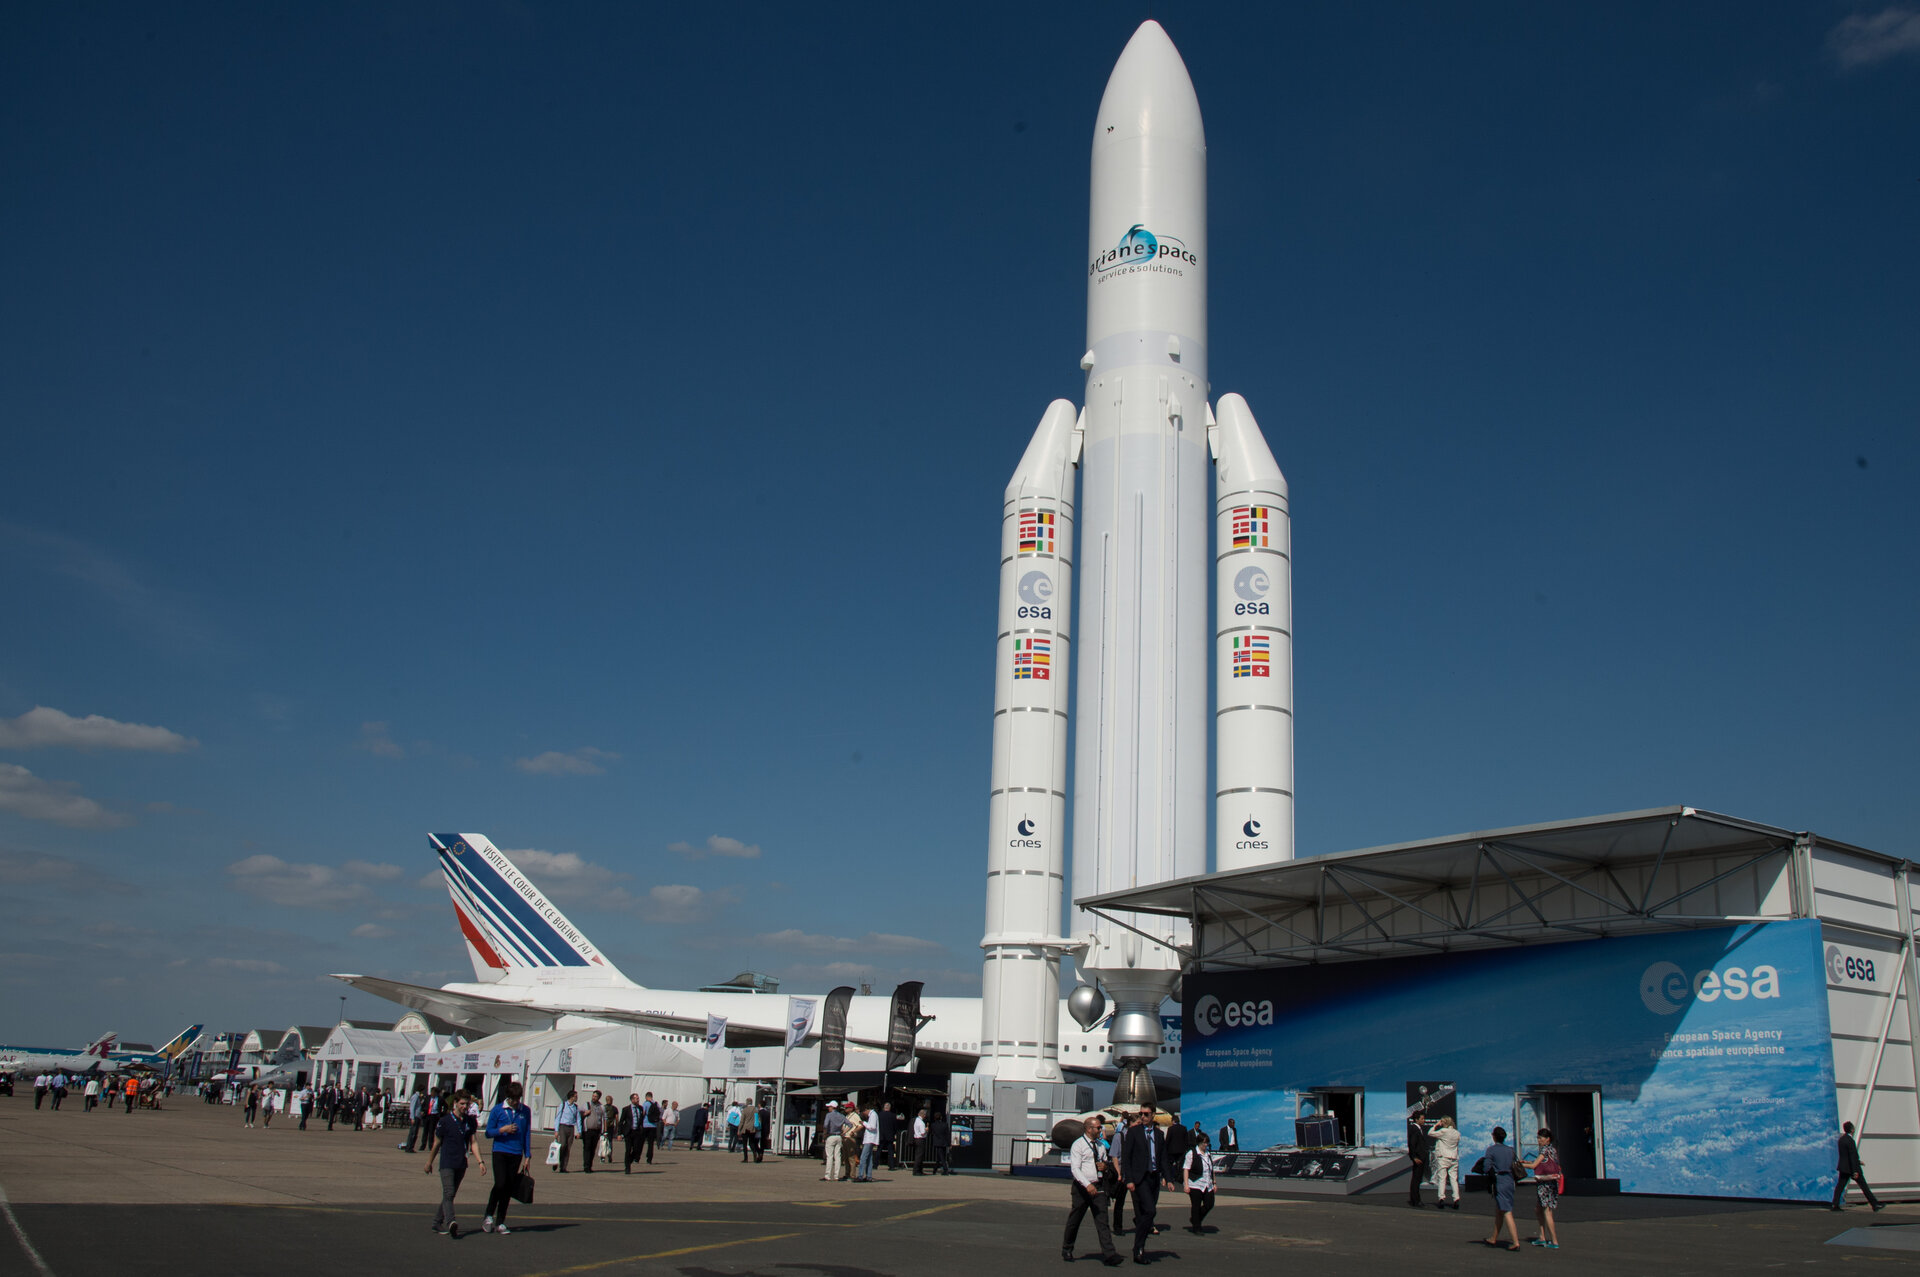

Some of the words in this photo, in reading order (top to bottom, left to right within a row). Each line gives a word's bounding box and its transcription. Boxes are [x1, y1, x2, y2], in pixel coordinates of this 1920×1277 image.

[1090, 244, 1197, 276] arianespace
[1017, 606, 1052, 620] esa
[1234, 602, 1270, 616] esa
[1009, 839, 1042, 849] cnes
[1236, 840, 1269, 850] cnes
[483, 845, 508, 871] VISITEZ
[504, 868, 516, 880] LE
[513, 877, 537, 901] COEUR
[534, 898, 545, 911] DE
[544, 908, 555, 920] CE
[553, 916, 580, 943] BOEING
[577, 940, 593, 955] 747
[1845, 956, 1876, 982] esa
[1692, 964, 1780, 1003] esa
[1224, 1000, 1273, 1027] esa
[1664, 1032, 1709, 1043] European
[1711, 1030, 1741, 1042] Space
[1744, 1029, 1782, 1042] Agency
[1206, 1048, 1231, 1057] European
[1232, 1047, 1249, 1056] Space
[1251, 1047, 1272, 1057] Agency
[1651, 1048, 1682, 1060] Agence
[1685, 1046, 1723, 1058] spatiale
[1726, 1045, 1784, 1057] européenne
[1197, 1060, 1216, 1069] Agence
[1217, 1059, 1238, 1068] spatiale
[1240, 1059, 1272, 1068] européenne
